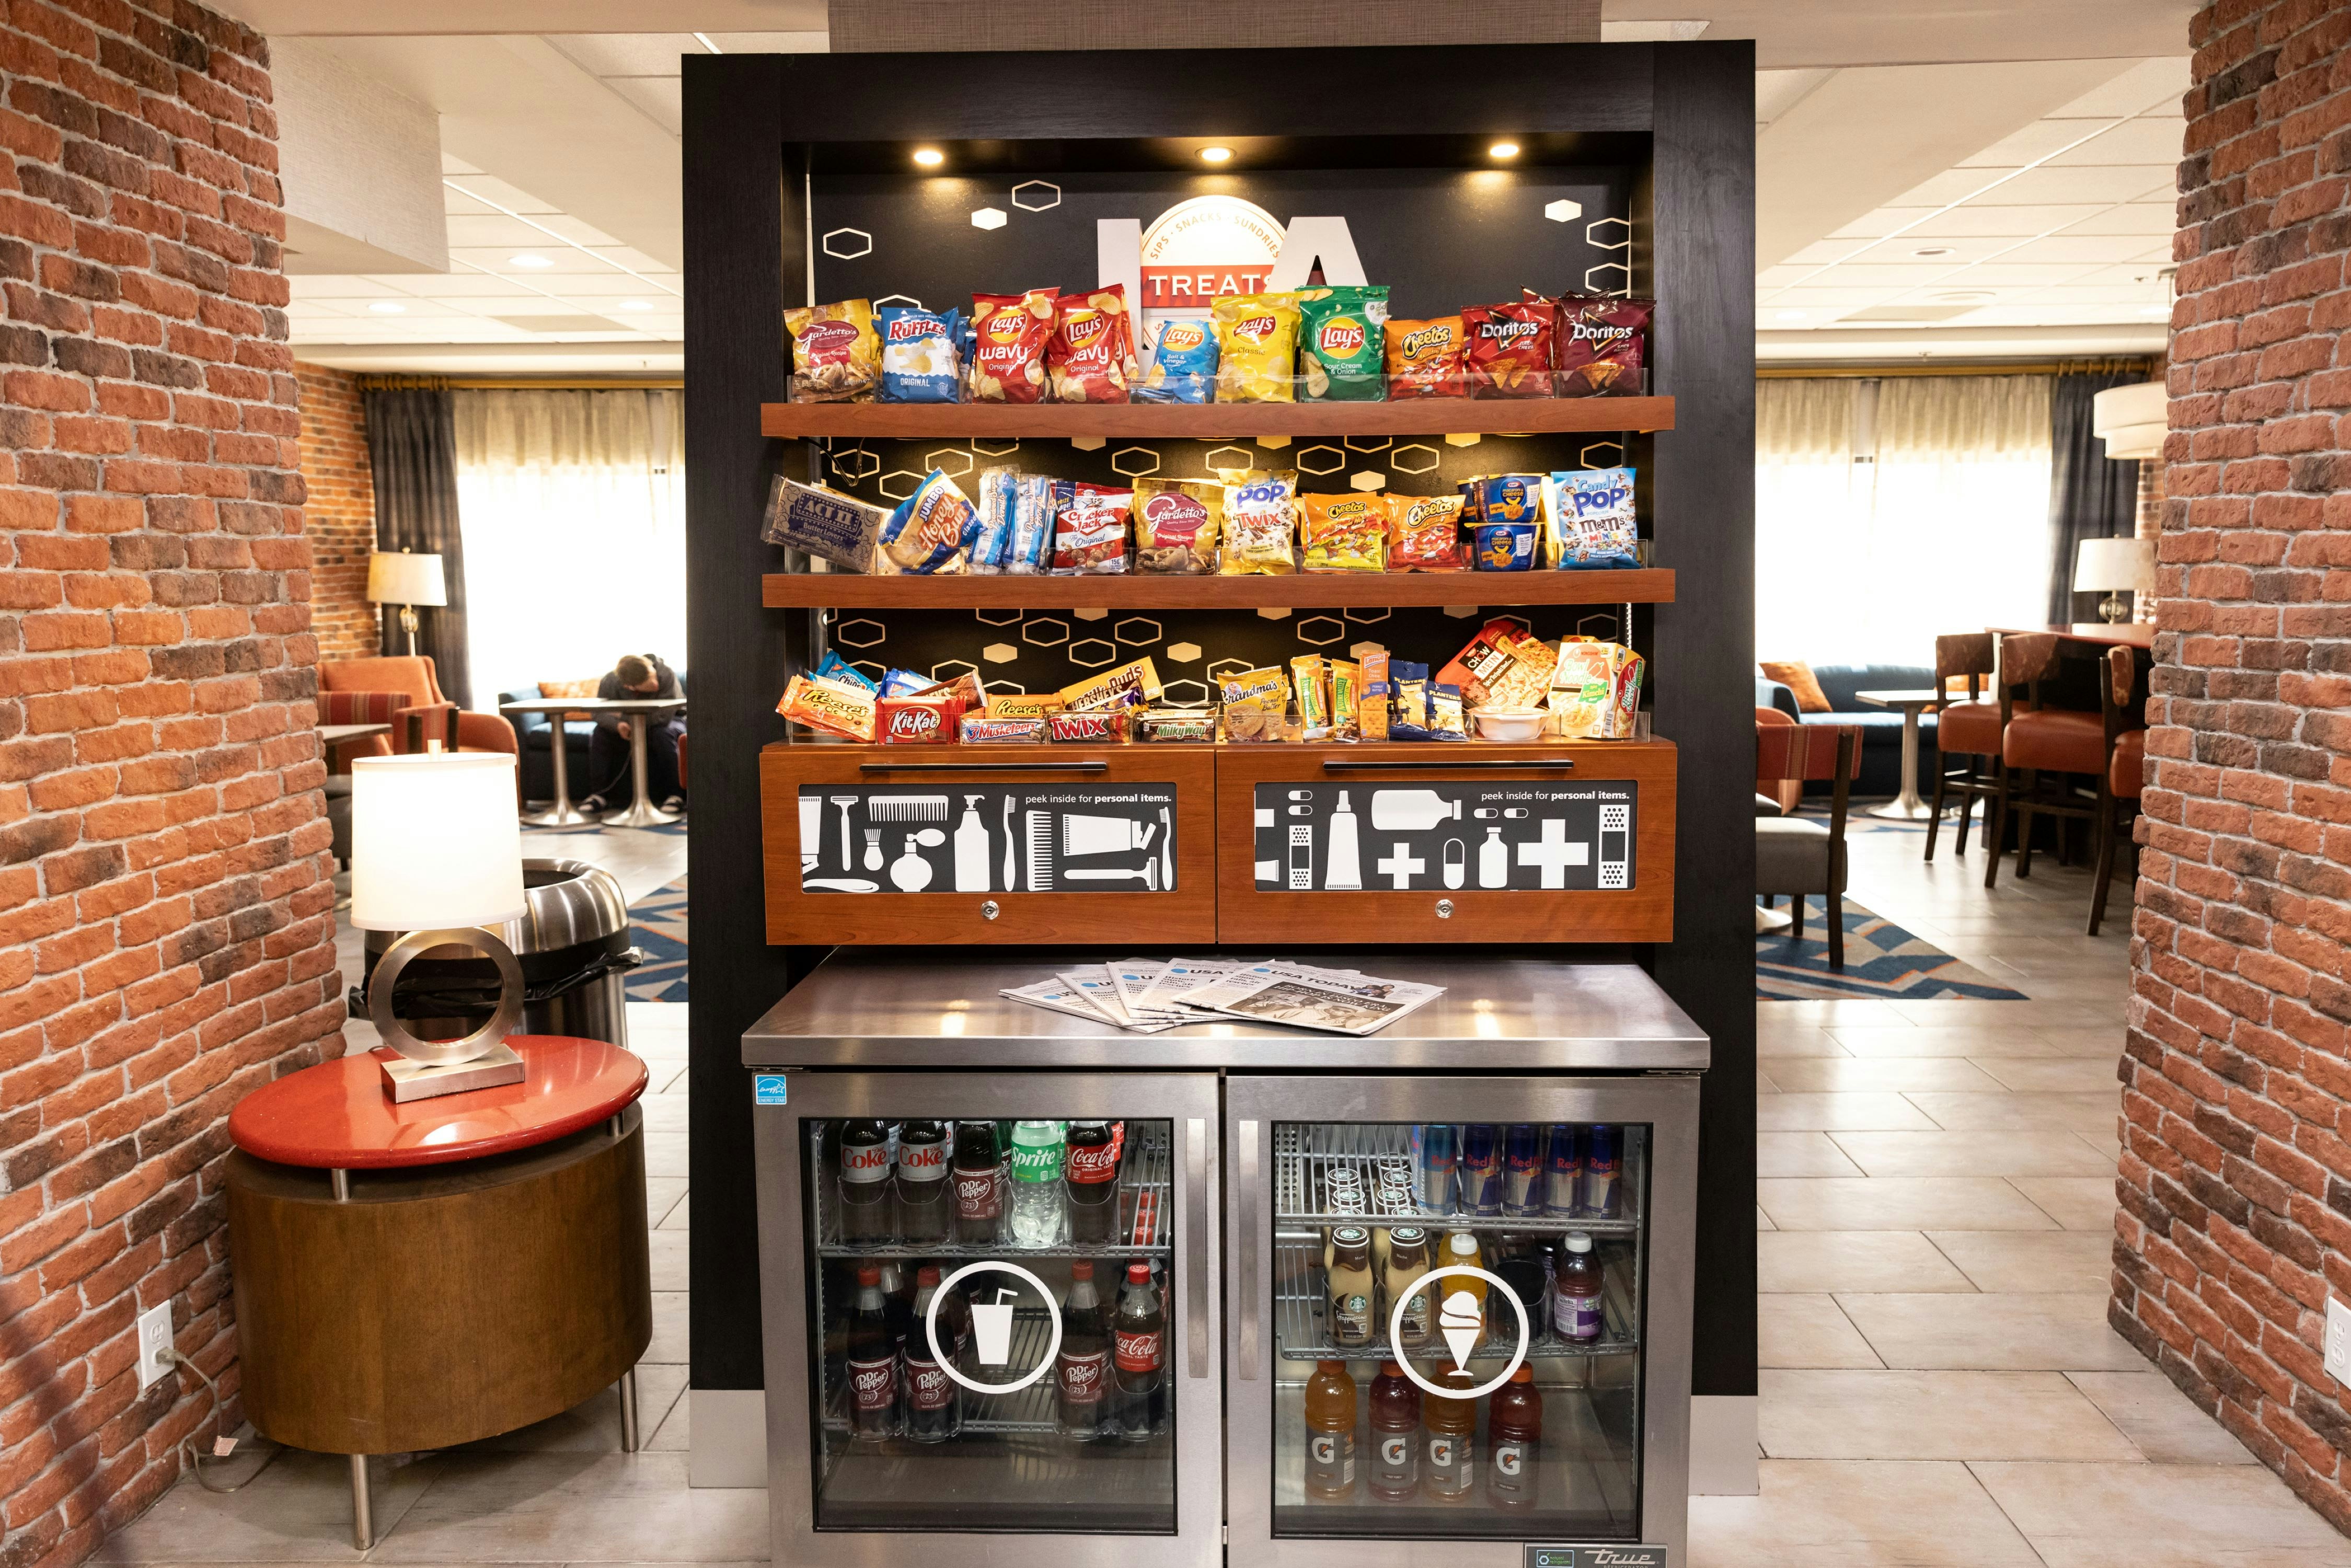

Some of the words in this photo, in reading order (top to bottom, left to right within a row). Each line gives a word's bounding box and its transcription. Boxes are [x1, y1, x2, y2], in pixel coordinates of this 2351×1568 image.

[1150, 236, 1170, 260] SIPS
[1176, 212, 1223, 233] SNACKS
[1234, 215, 1280, 259] SUNDRIES
[889, 319, 946, 341] RUFFLES
[989, 315, 1025, 335] Lay's
[1070, 317, 1101, 342] Lay's
[1236, 316, 1274, 335] Lay's
[1481, 322, 1539, 339] Doritos
[1573, 322, 1634, 340] Doritos
[1163, 329, 1202, 345] Lay's
[1323, 327, 1363, 350] Lay's
[1401, 326, 1453, 360] Cheetos
[979, 343, 1029, 364] wavy
[1238, 347, 1266, 356] Classic
[988, 363, 1017, 372] Original
[1070, 364, 1099, 373] Original
[901, 377, 930, 387] ORIGINAL
[1577, 475, 1618, 493] Candy
[919, 486, 944, 522] JUMBO
[1237, 485, 1285, 511] POP
[1572, 488, 1627, 518] POP
[803, 500, 835, 518] ACT
[1328, 501, 1367, 520] Cheetos
[1406, 499, 1456, 528] Cheetos
[919, 495, 959, 549] Honey
[938, 507, 967, 546] Bun
[1073, 518, 1102, 533] Jack
[803, 522, 824, 534] Butter
[824, 528, 844, 541] Lovers
[1075, 533, 1106, 547] Original
[1468, 646, 1491, 668] CHOW
[1478, 654, 1500, 675] MEIN
[1564, 659, 1590, 672] Bowl
[1394, 676, 1426, 685] PLANTERS
[1070, 685, 1123, 711] HERSHEY'S
[1220, 681, 1278, 706] Grandma's
[1260, 695, 1280, 705] Peanut
[1428, 690, 1461, 701] PLANTERS
[1583, 688, 1605, 698] Kimchi
[803, 689, 869, 716] Reese's
[995, 700, 1042, 716] Reese's
[967, 726, 978, 740] 3
[978, 722, 1038, 740] Musketeers
[1025, 794, 1047, 804] peek
[1050, 794, 1076, 803] inside
[1079, 793, 1092, 803] for
[1094, 793, 1138, 804] personal
[1140, 793, 1172, 802] items.
[1481, 791, 1503, 802] peek
[1506, 791, 1532, 800] inside
[1535, 790, 1549, 800] for
[1551, 790, 1595, 801] personal
[1598, 790, 1630, 799] items.
[1271, 970, 1303, 979] USA
[1306, 977, 1355, 990] TODAY
[842, 1148, 887, 1169] Coke
[899, 1145, 943, 1167] Coke
[1011, 1147, 1056, 1168] Sprite
[1432, 1154, 1450, 1166] Red
[1467, 1154, 1488, 1168] Red
[1511, 1155, 1532, 1168] Red
[1557, 1157, 1578, 1169] Red
[1591, 1157, 1614, 1170] Red
[960, 1182, 988, 1199] Pepper
[968, 1180, 981, 1190] Dr
[866, 1371, 879, 1380] Dr
[928, 1370, 941, 1379] Dr
[1067, 1366, 1096, 1383] Pepper
[1077, 1365, 1089, 1374] Dr
[857, 1372, 886, 1390] Pepper
[1311, 1437, 1334, 1464] G
[1381, 1437, 1406, 1466] G
[1430, 1439, 1451, 1467] G
[1496, 1446, 1521, 1475] G
